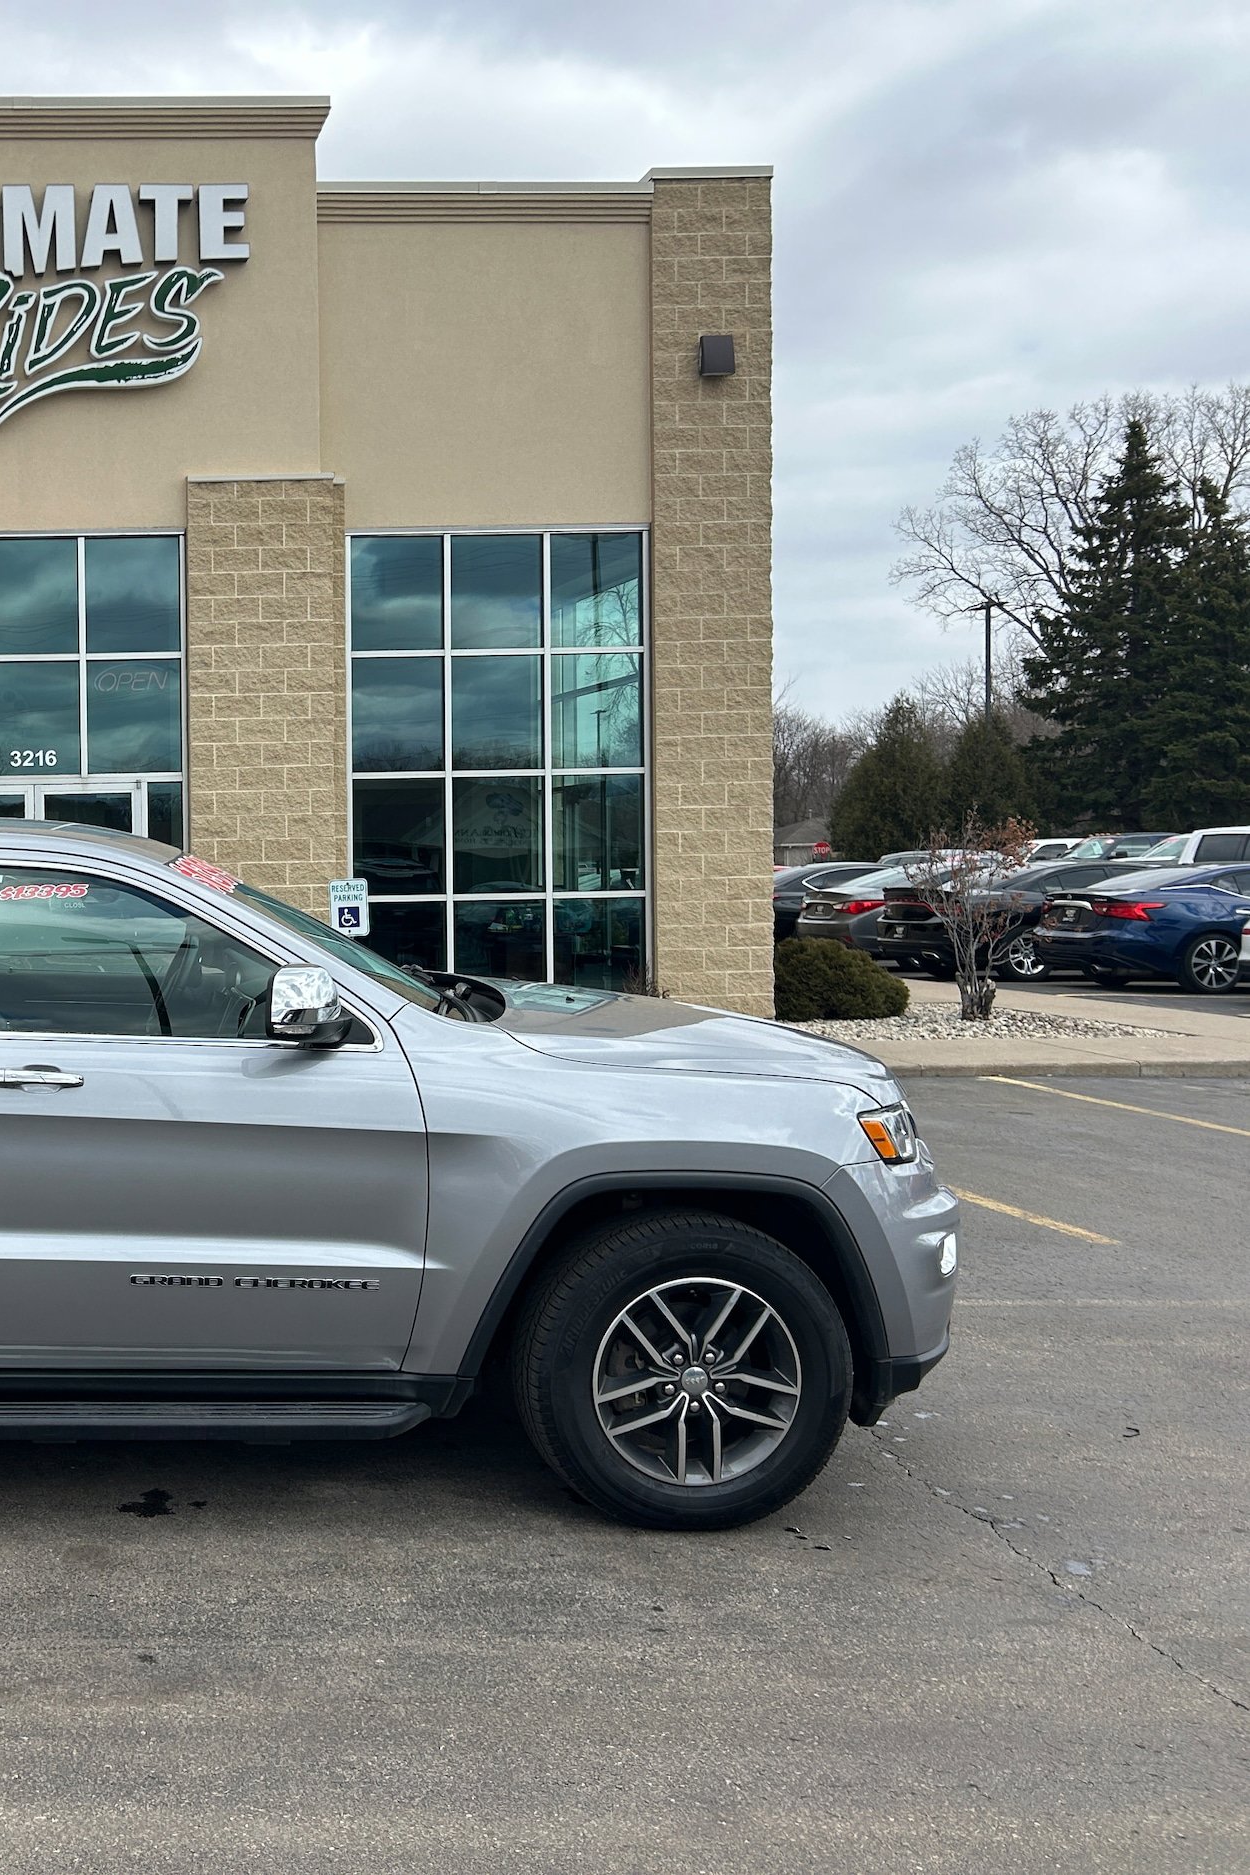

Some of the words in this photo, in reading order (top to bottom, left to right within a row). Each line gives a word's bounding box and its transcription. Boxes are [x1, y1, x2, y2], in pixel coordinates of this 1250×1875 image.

[98, 671, 168, 692] OPEN
[10, 750, 57, 767] 3216
[813, 846, 830, 854] STOP
[331, 884, 365, 893] RESERVED
[333, 894, 363, 902] PARKING
[130, 1274, 224, 1288] GRAND
[234, 1276, 380, 1291] CHEROKEE
